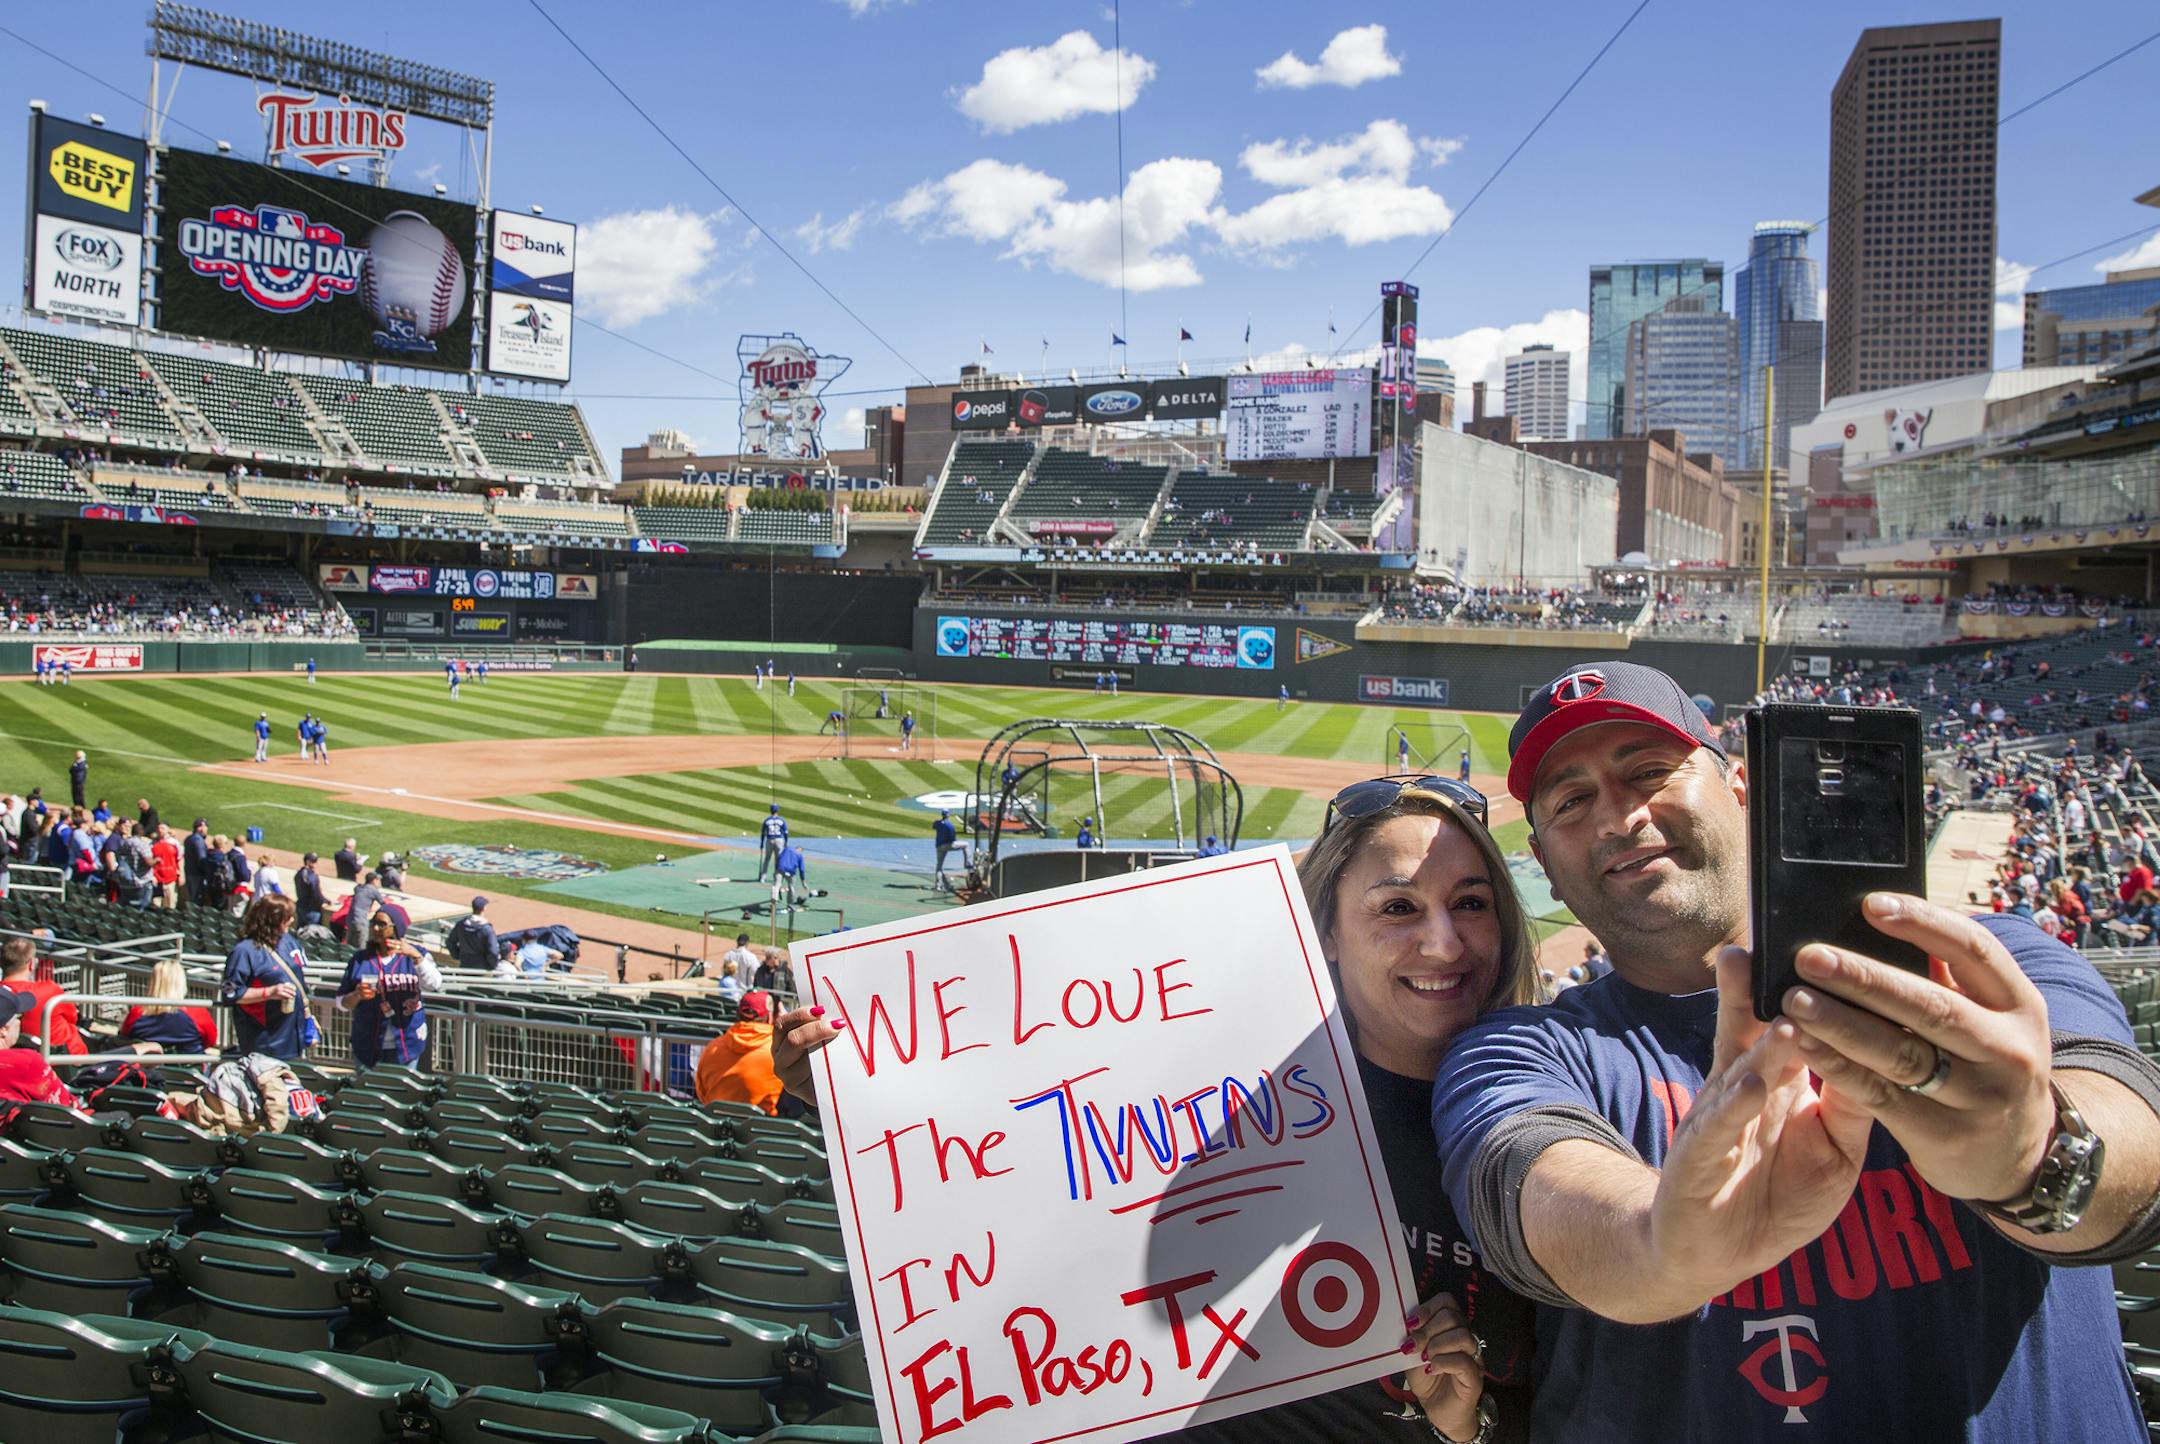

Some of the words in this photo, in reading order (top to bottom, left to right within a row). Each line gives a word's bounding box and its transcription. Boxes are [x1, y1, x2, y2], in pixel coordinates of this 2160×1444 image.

[257, 91, 406, 155] Twins
[63, 151, 130, 185] BEST
[64, 170, 122, 199] BUY
[70, 234, 109, 258] FOX
[182, 221, 312, 271] OPENING
[314, 245, 366, 278] DAY
[68, 252, 110, 267] SPORTS
[54, 270, 121, 299] NORTH
[389, 319, 415, 338] KC
[540, 331, 564, 347] Island
[746, 357, 817, 389] Twins
[973, 401, 1006, 418] pepsi
[1096, 394, 1130, 411] Ford
[1171, 392, 1217, 406] DELTA
[1324, 403, 1341, 412] LAD
[684, 469, 784, 489] TARGET
[810, 475, 883, 492] FIELD
[439, 568, 467, 580] APRIL
[501, 571, 532, 583] TWINS
[435, 581, 471, 595] 27-29
[500, 586, 532, 598] TIGERS
[455, 617, 507, 630] SUBWAY
[1366, 677, 1443, 699] usbank
[822, 950, 992, 1077] WE
[1008, 1064, 1336, 1202] TWINS
[878, 1230, 996, 1335] IN
[900, 1339, 1014, 1444] EL
